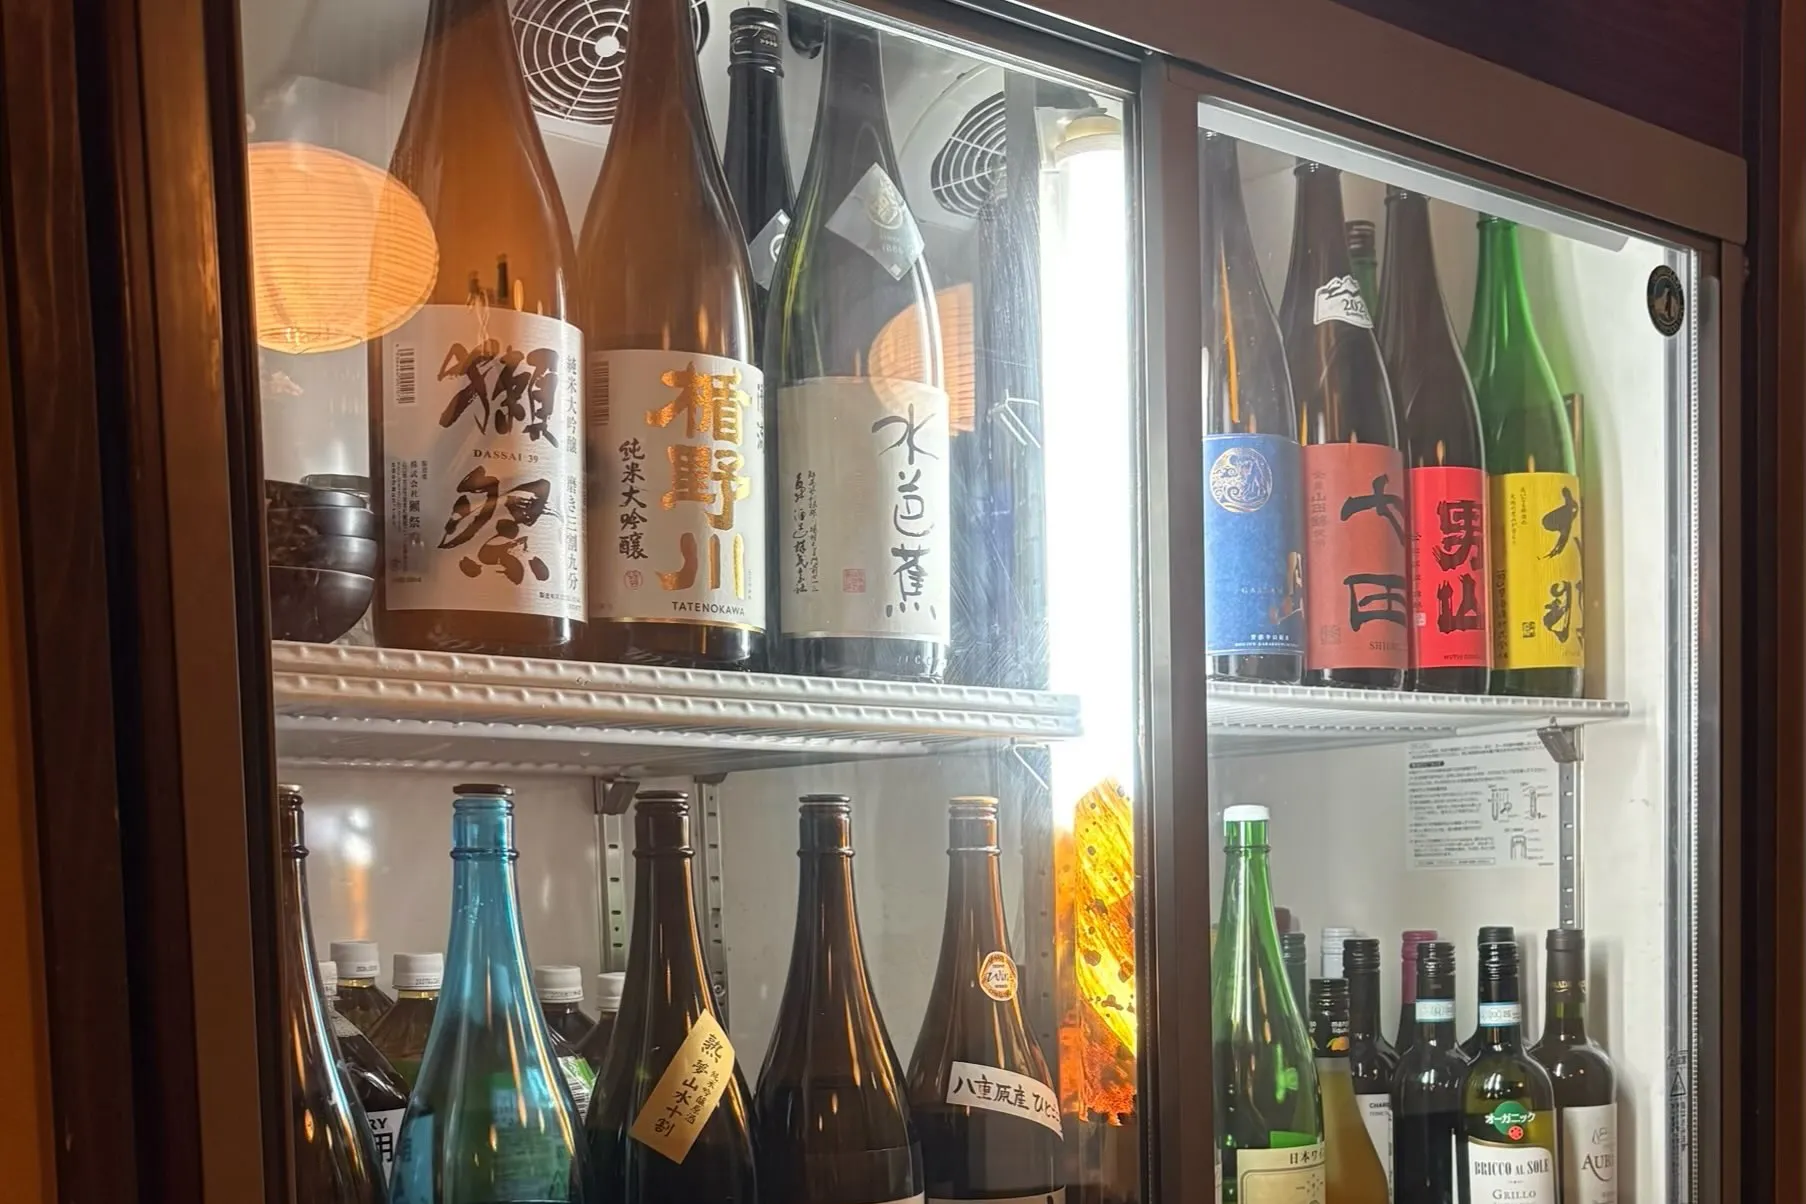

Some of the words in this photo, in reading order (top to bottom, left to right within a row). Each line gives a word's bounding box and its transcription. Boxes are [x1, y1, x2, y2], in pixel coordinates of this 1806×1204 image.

[437, 338, 561, 586] 獺祭
[472, 449, 522, 462] DASSAI
[527, 454, 540, 463] 39
[618, 437, 649, 561] 純米大吟醸
[871, 402, 940, 620] 水芭蕉
[671, 601, 745, 617] TATENOKAWA
[953, 1076, 1030, 1111] 八重原産
[1485, 1111, 1536, 1125] オーガニック
[1289, 1152, 1324, 1165] 日本ワイ
[1474, 1160, 1512, 1176] BRICCO
[1527, 1158, 1549, 1175] SOLE
